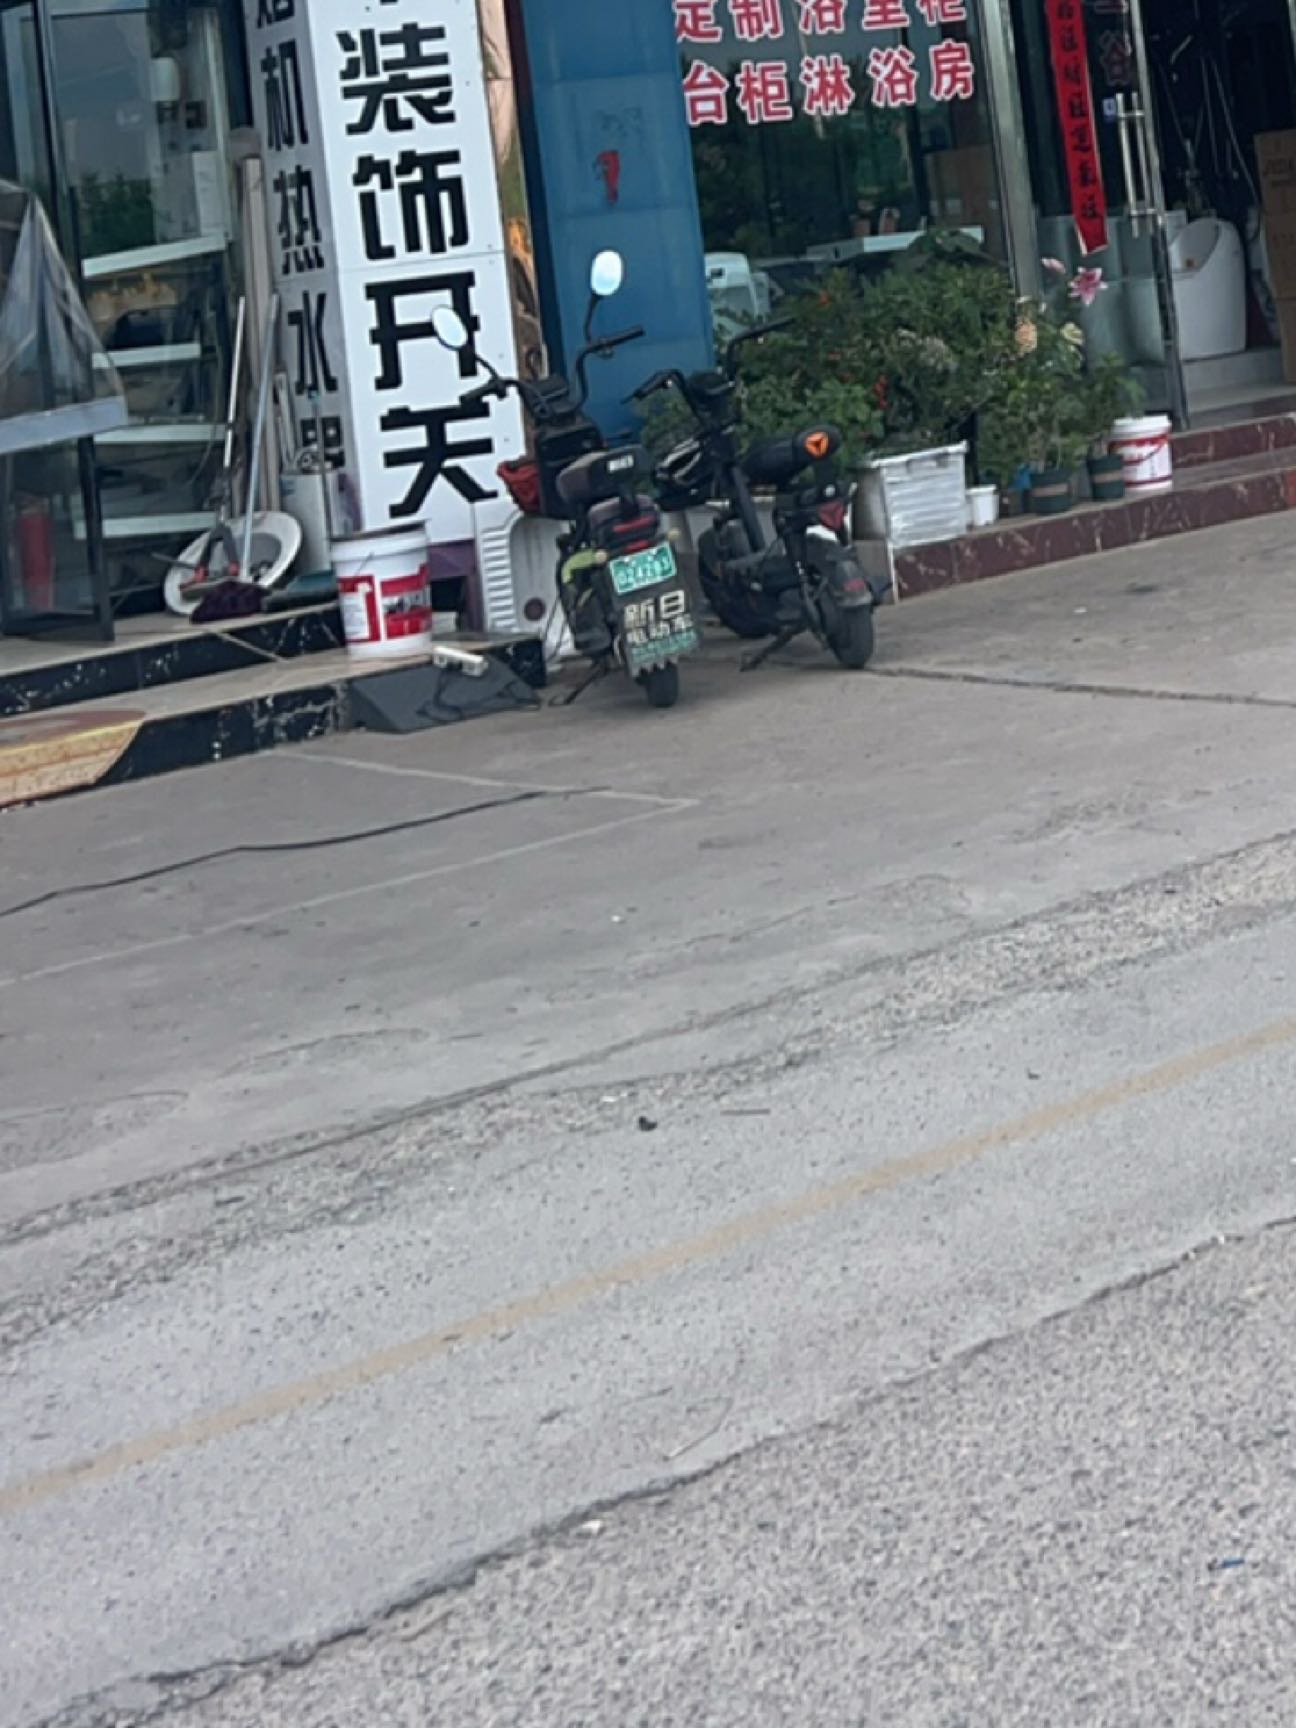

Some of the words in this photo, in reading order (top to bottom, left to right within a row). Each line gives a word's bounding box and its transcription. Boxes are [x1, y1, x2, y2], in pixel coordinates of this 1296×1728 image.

[682, 38, 976, 125] 台柜淋浴房
